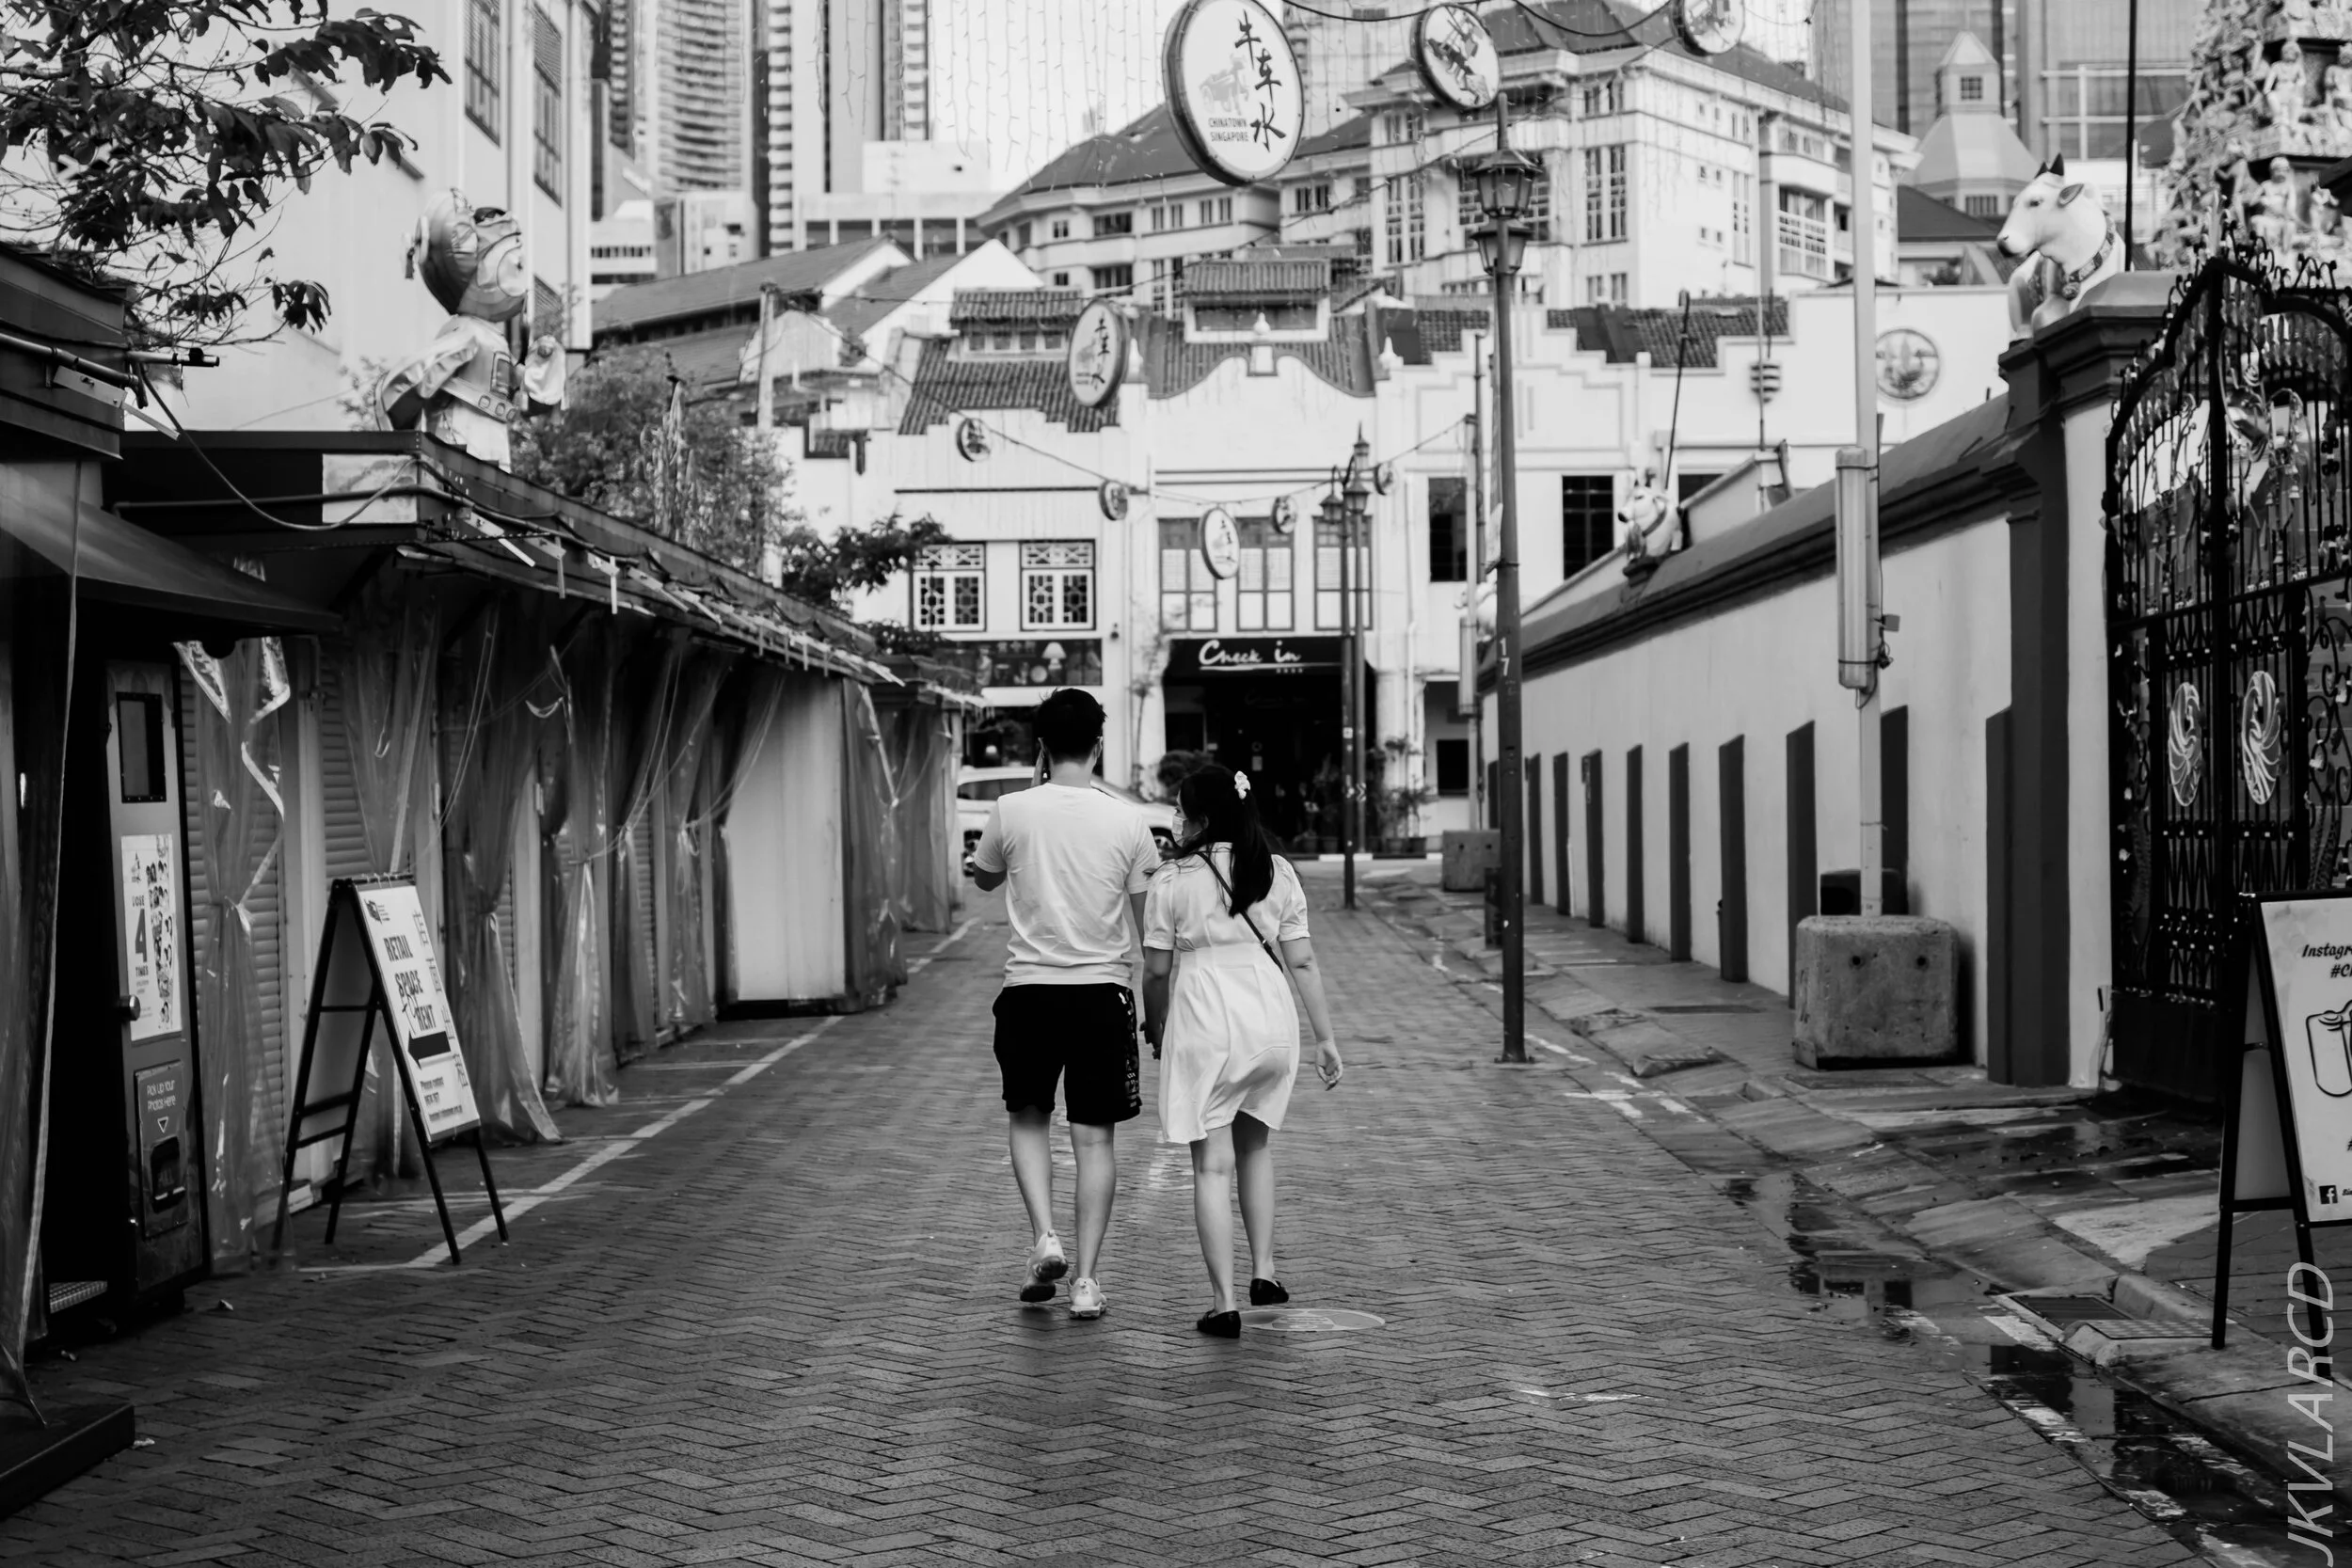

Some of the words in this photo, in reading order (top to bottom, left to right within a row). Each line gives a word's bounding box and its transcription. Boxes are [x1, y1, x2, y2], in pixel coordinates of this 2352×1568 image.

[1208, 117, 1247, 128] CHINATOWN
[1210, 132, 1249, 142] SINGAPORE
[1199, 639, 1263, 665] Check
[1274, 640, 1301, 663] in
[135, 909, 148, 962] 4
[383, 935, 414, 962] RETAIL
[2301, 942, 2352, 959] Instagr
[394, 970, 423, 998] SPACE
[414, 1004, 437, 1032] RENT
